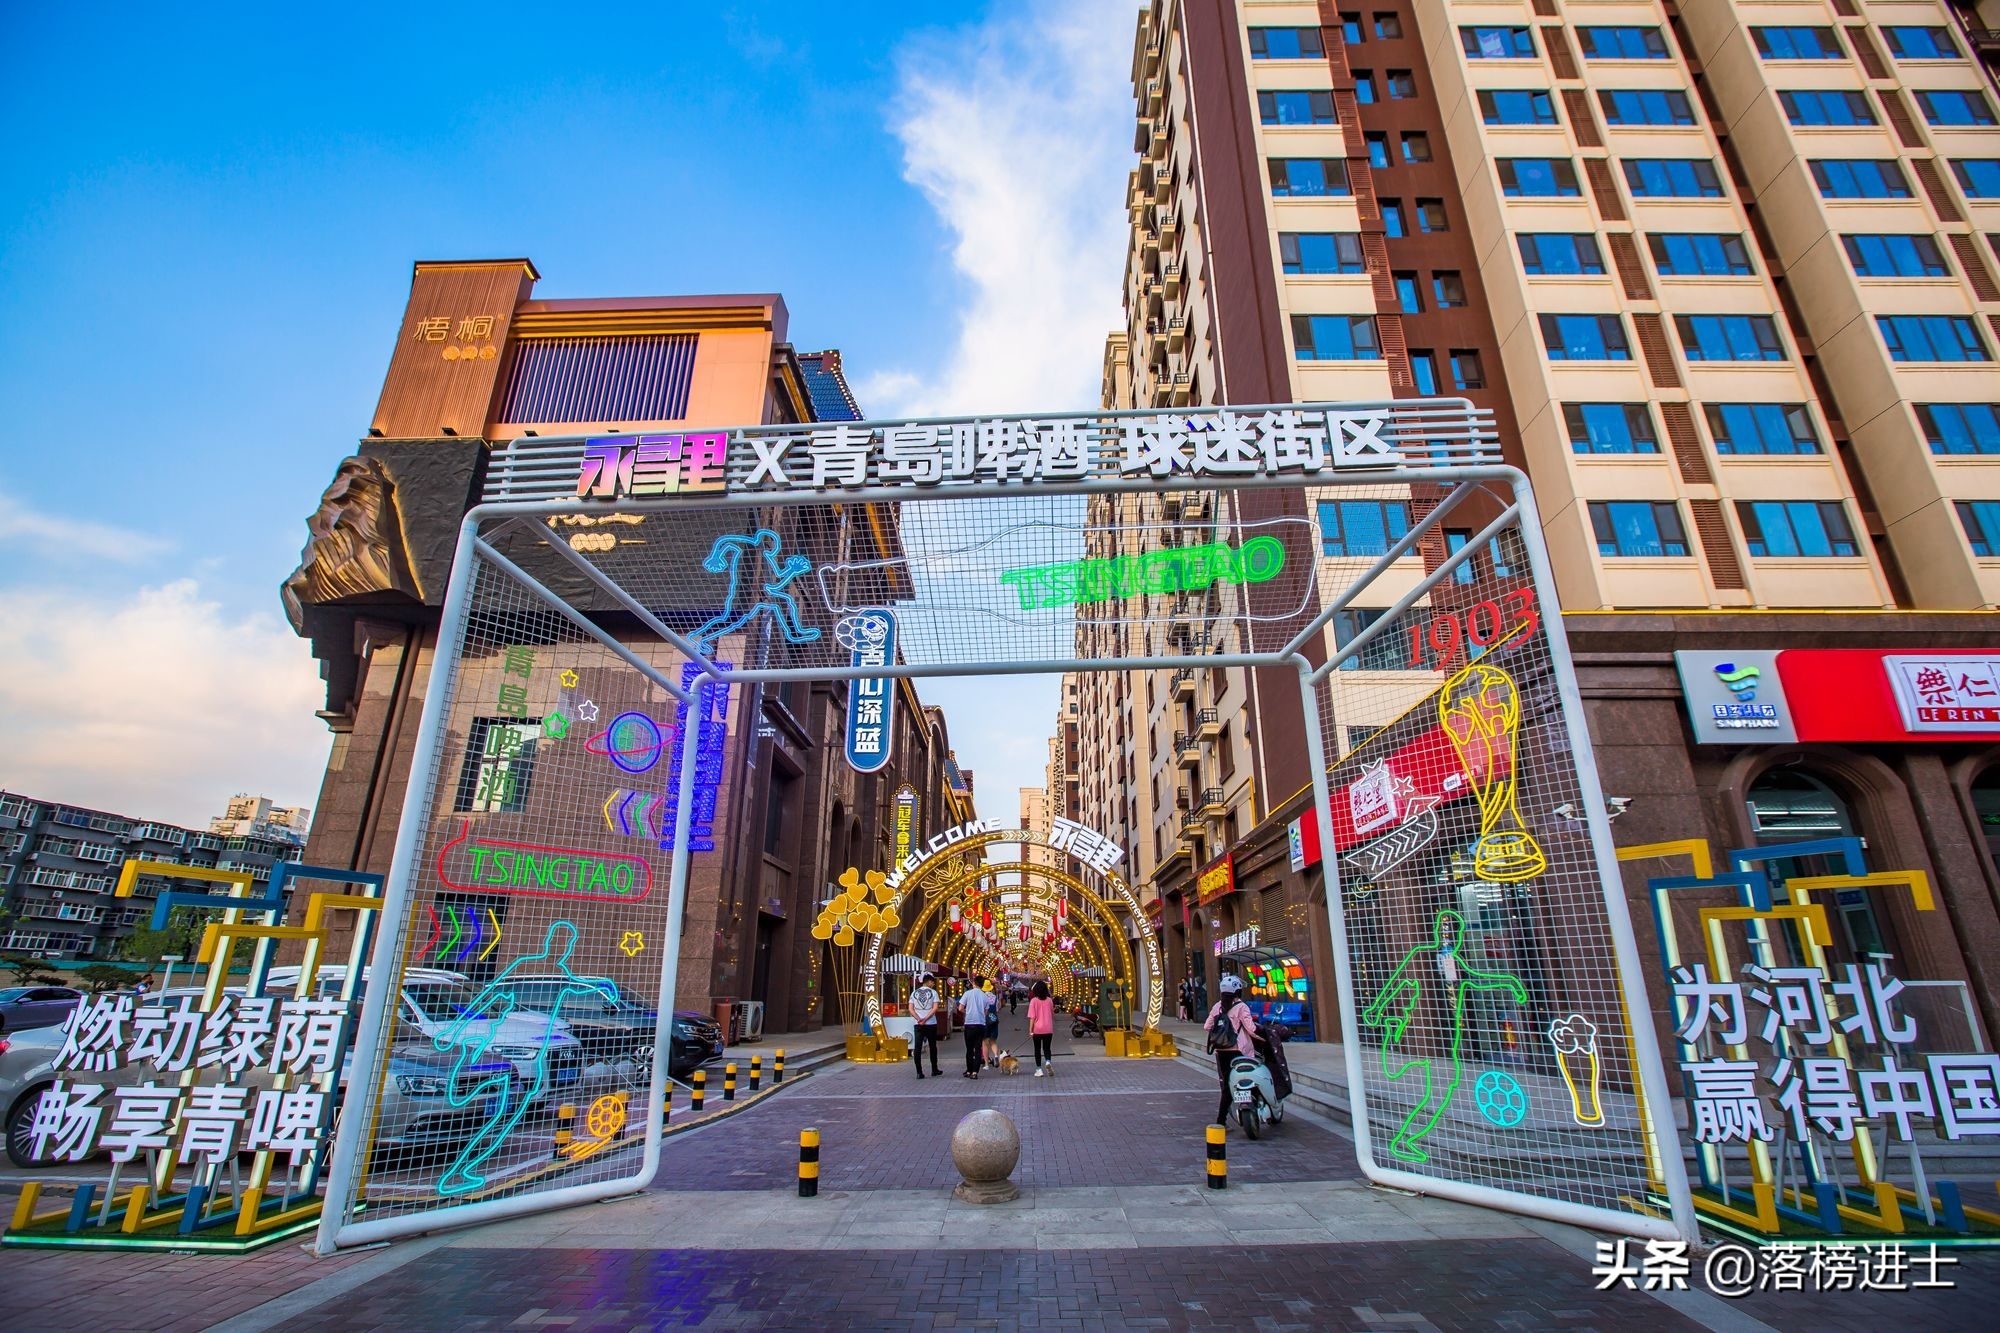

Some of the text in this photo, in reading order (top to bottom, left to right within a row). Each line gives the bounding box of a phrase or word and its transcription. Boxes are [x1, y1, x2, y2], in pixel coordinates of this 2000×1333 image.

[413, 315, 495, 342] 梧桐
[807, 417, 1090, 489] 青岛啤酒
[1118, 408, 1401, 478] 球迷街区
[1000, 535, 1286, 610] TSINGTAO
[1407, 587, 1538, 672] 1903
[477, 643, 537, 803] 青岛啤酒
[1715, 719, 1781, 730] SINOPHARM
[1921, 708, 1940, 721] LE
[1947, 709, 1986, 721] REN
[468, 848, 634, 893] TSINGTAO
[885, 816, 1001, 889] WELCOME
[1111, 877, 1154, 939] Commercial
[1146, 940, 1161, 976] Street
[50, 995, 349, 1075] 燃动绿荫
[1673, 963, 1918, 1045] 为河北
[31, 1079, 325, 1167] 畅享青啤
[1680, 1053, 2000, 1143] 赢得中国
